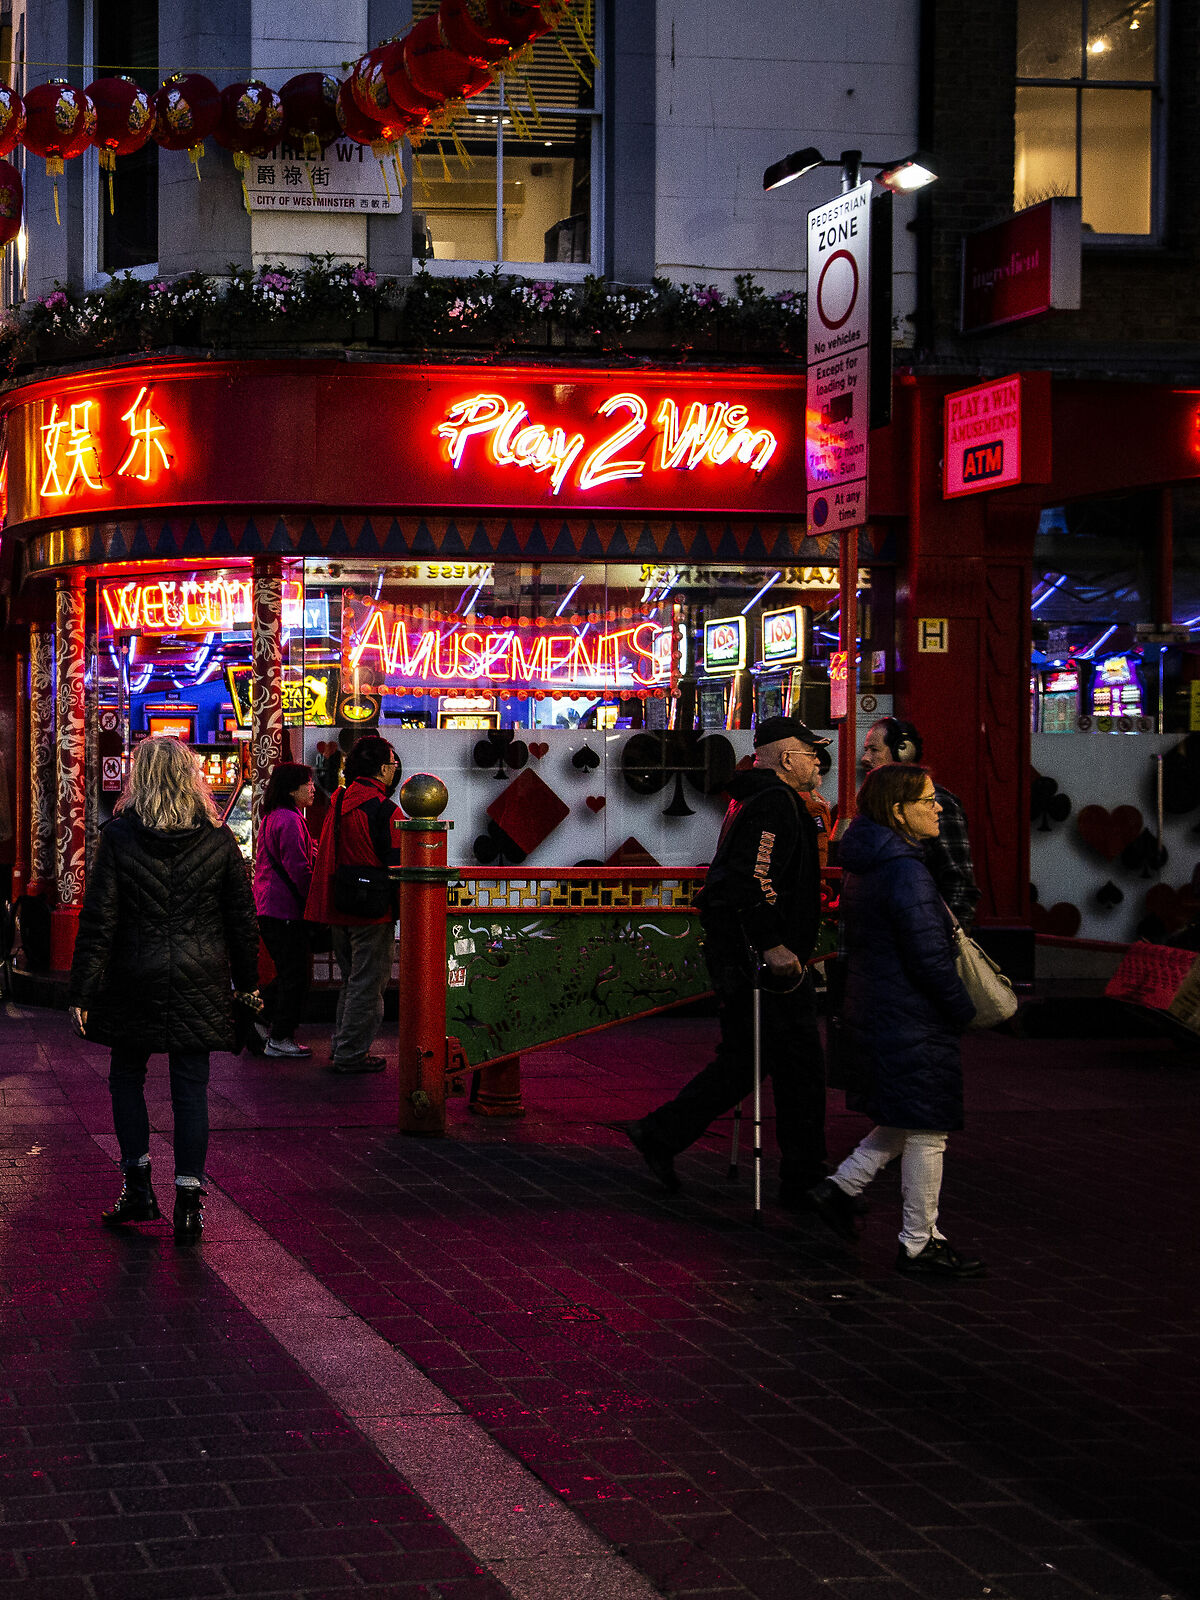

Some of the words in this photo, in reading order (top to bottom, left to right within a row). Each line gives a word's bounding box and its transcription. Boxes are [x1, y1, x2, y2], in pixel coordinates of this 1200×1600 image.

[336, 143, 364, 163] W1
[257, 165, 330, 186] 爵祿街
[257, 196, 274, 205] CITY
[279, 197, 290, 205] OF
[293, 197, 355, 207] WESTMINSTER
[811, 193, 867, 230] PEDESTRIAN
[818, 216, 858, 252] ZONE
[814, 341, 826, 355] No
[827, 329, 861, 350] vehicles
[816, 361, 844, 380] Except
[845, 356, 858, 370] for
[816, 378, 846, 396] loading
[847, 374, 858, 388] by
[951, 395, 980, 422] PLAY
[993, 386, 1016, 410] WIN
[819, 428, 854, 448] between
[949, 411, 1017, 445] AMUSEMENTS
[437, 393, 585, 495] Play
[579, 392, 649, 491] 2
[656, 398, 777, 472] Win
[844, 442, 865, 456] noon
[839, 462, 856, 475] Sun
[964, 445, 1001, 478] ATM
[835, 494, 845, 505] At
[846, 490, 861, 504] any
[838, 507, 857, 522] time
[351, 611, 664, 685] AMUSEMENTS
[281, 687, 311, 698] OYAL
